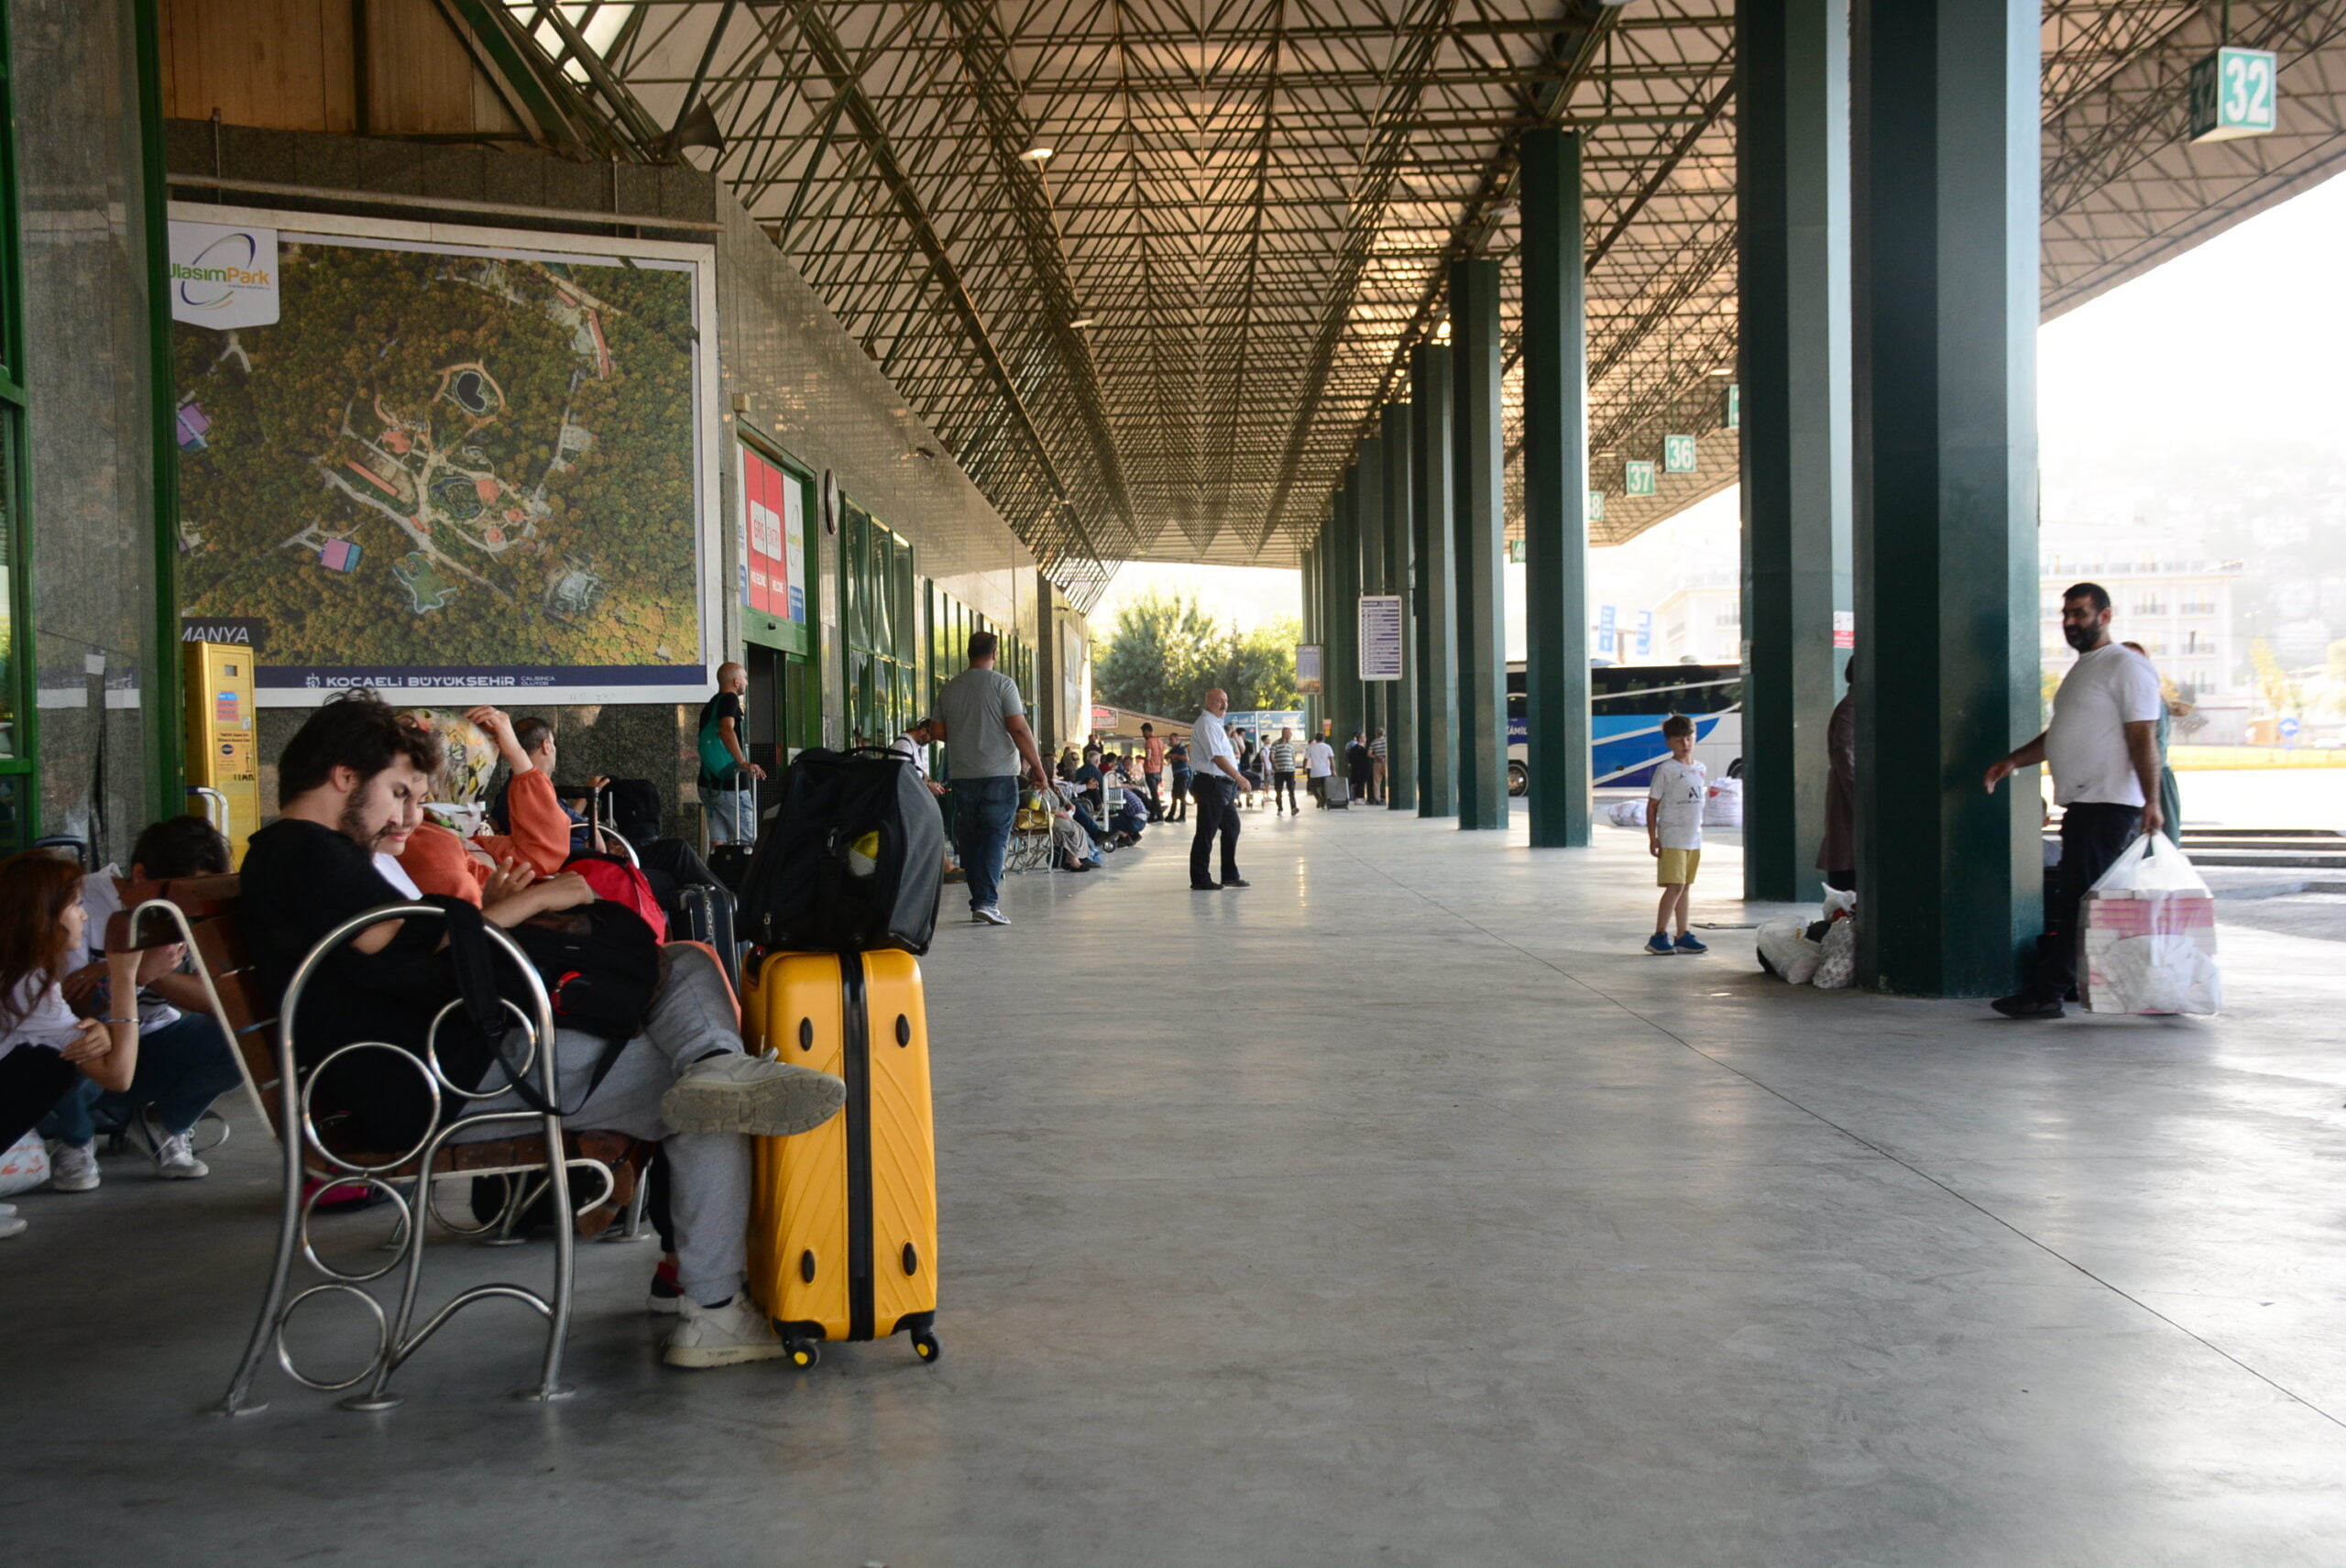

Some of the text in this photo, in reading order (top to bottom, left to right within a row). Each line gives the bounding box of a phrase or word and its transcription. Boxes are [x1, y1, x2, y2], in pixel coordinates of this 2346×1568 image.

[2225, 56, 2270, 123] 32
[1669, 439, 1693, 469] 36
[1630, 465, 1650, 491] 37
[1589, 496, 1601, 520] 8
